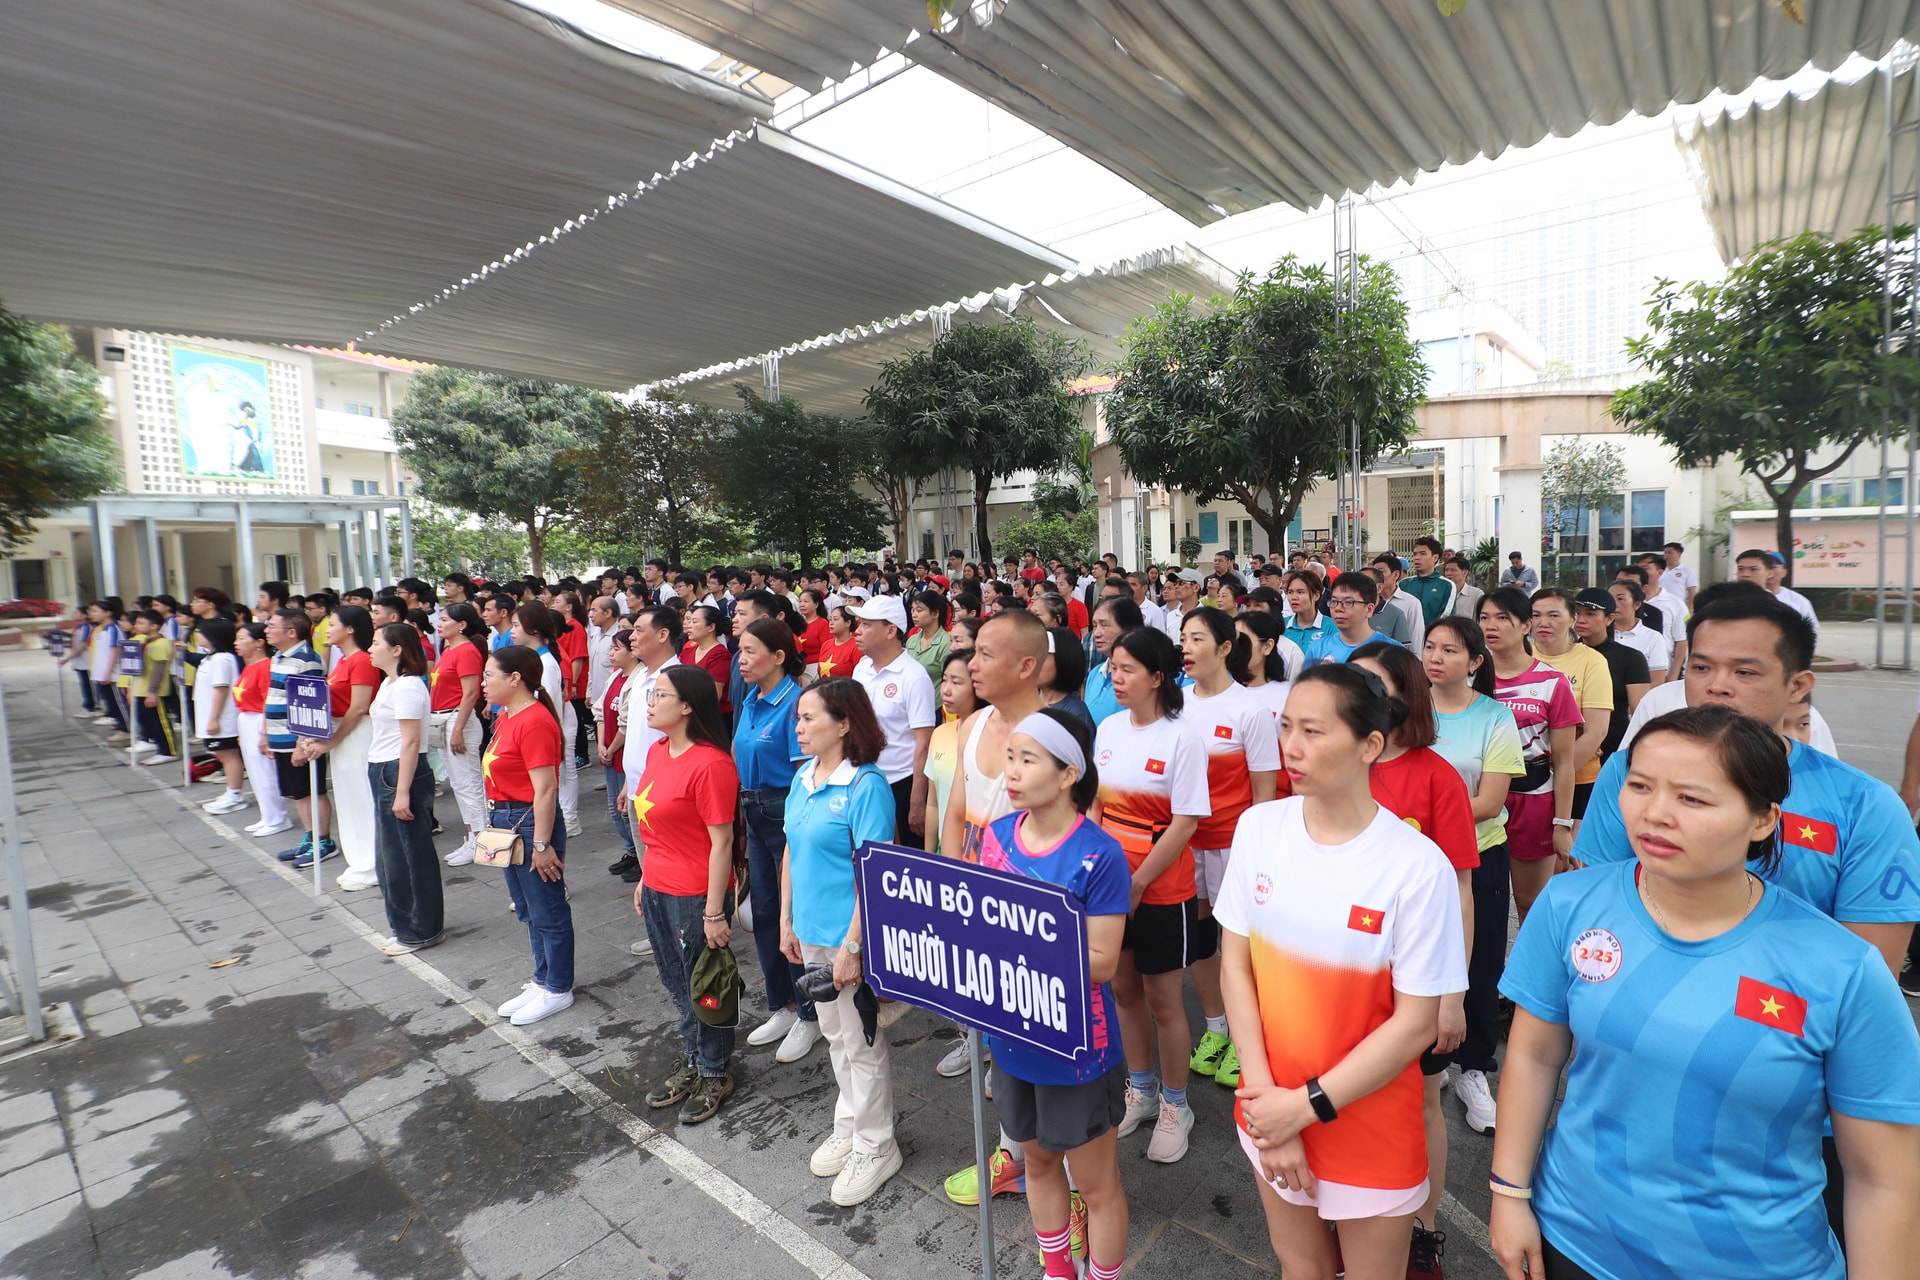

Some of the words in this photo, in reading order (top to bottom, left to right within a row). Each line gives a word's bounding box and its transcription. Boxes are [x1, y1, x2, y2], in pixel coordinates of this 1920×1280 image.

[297, 681, 316, 698] KHỐI
[312, 703, 328, 730] PHỐ
[881, 867, 934, 908] CÁN
[939, 881, 974, 927] BỘ
[981, 895, 1058, 943] CNVC
[881, 923, 949, 990] NGƯỜI
[951, 944, 995, 1006] LAO
[999, 954, 1068, 1034] ĐỘNG
